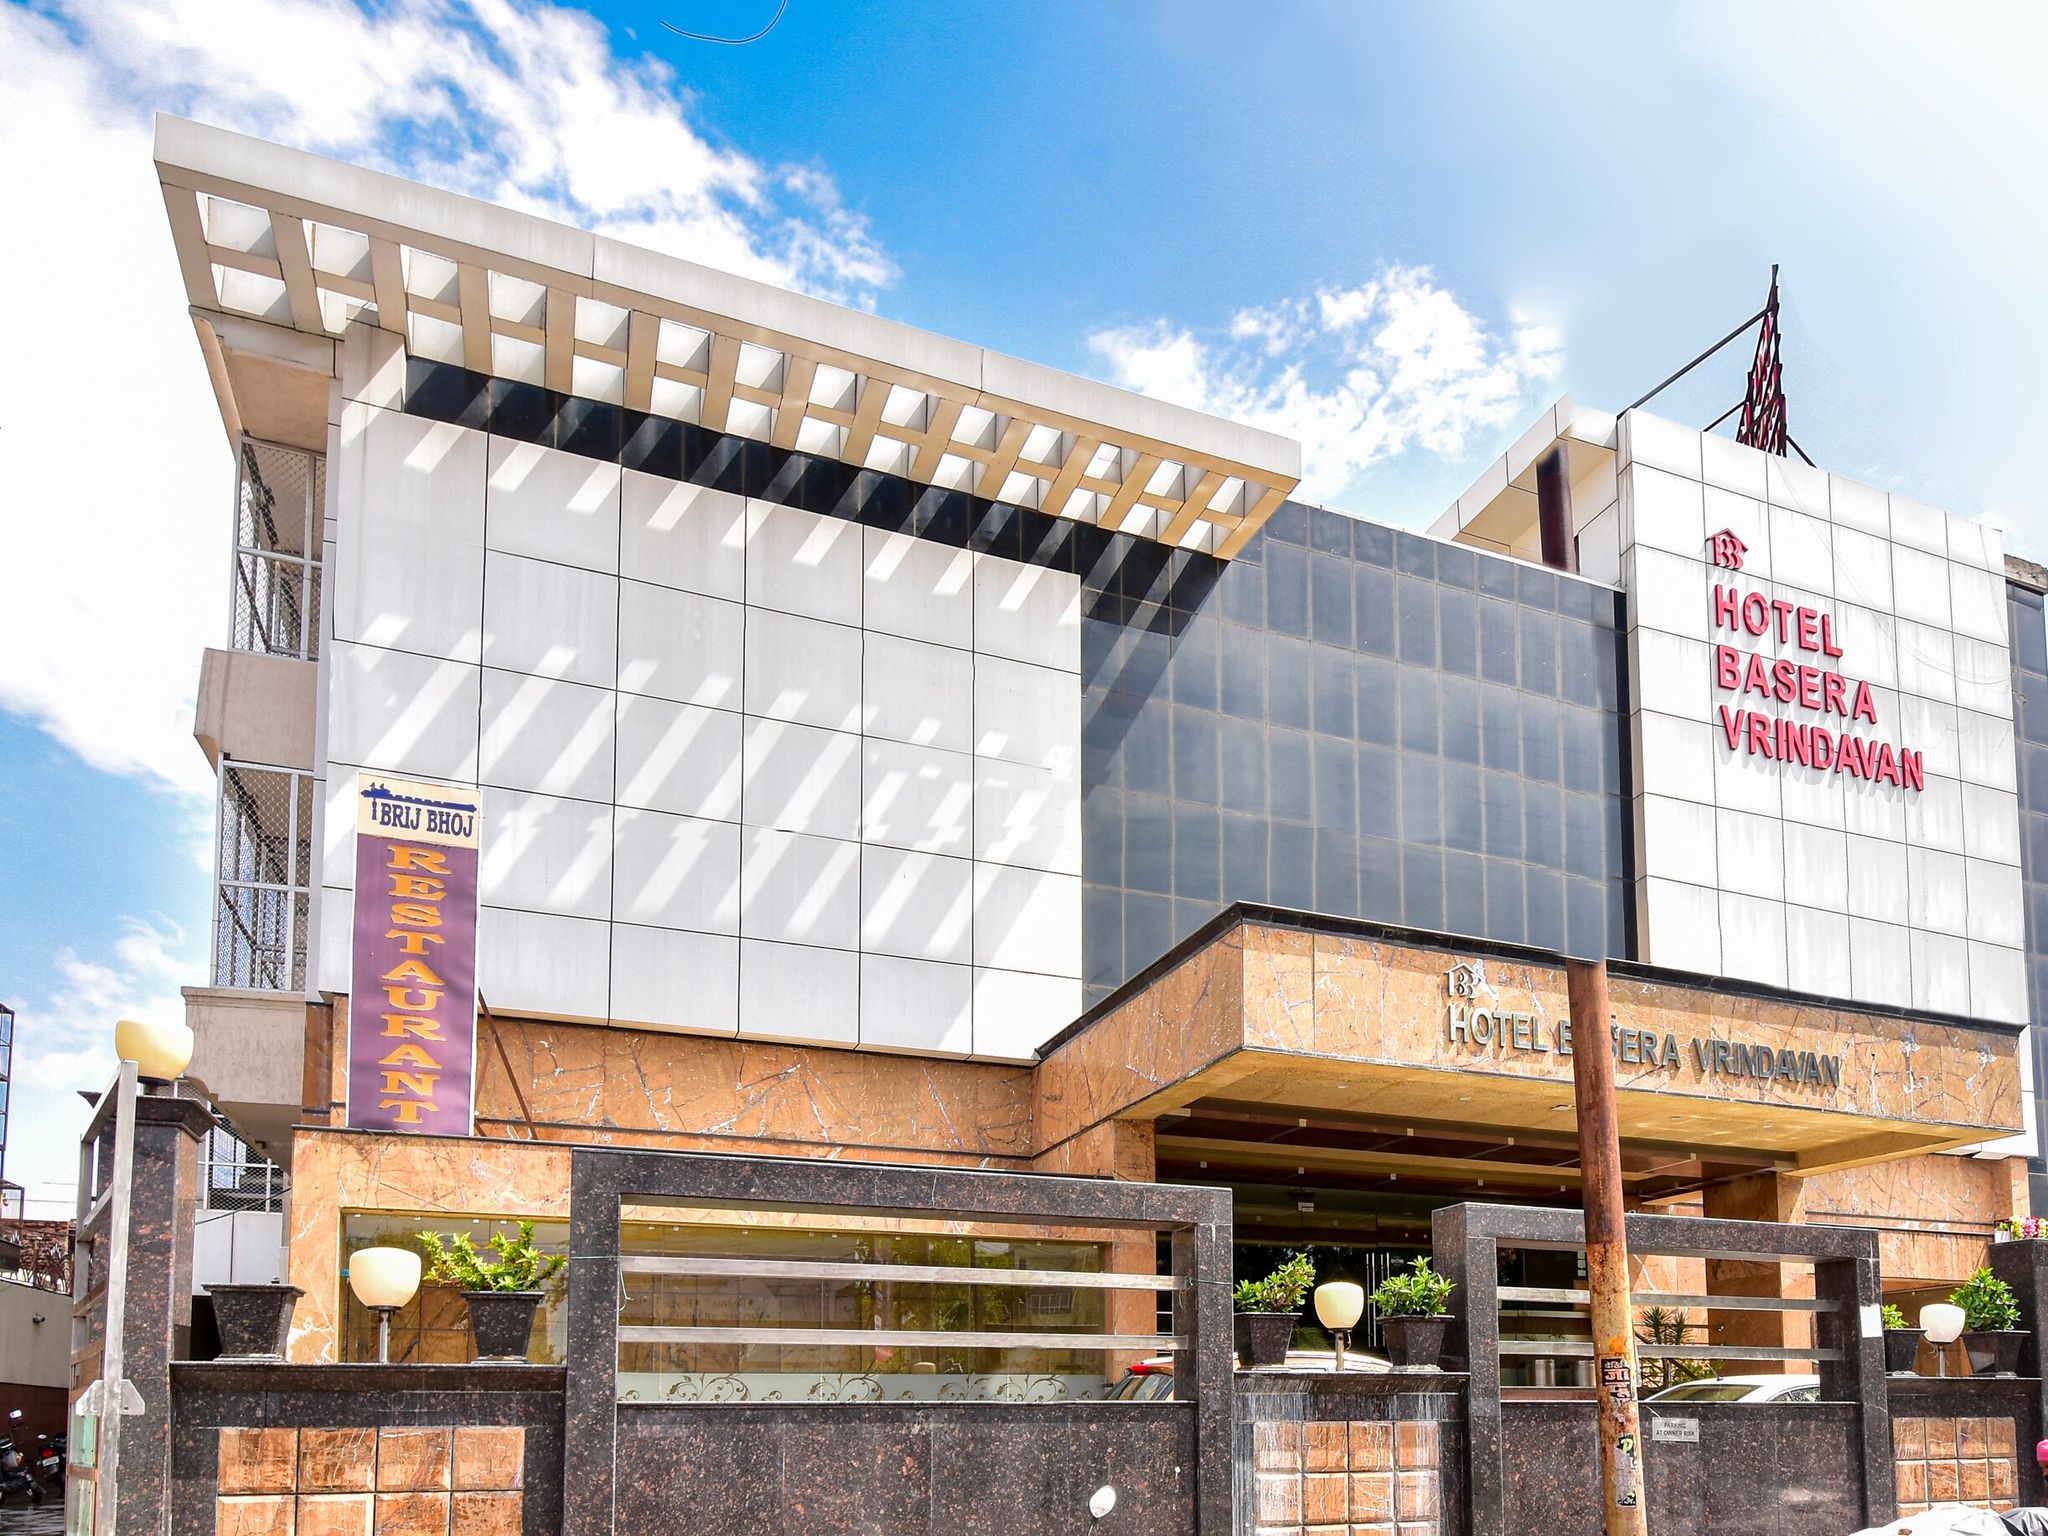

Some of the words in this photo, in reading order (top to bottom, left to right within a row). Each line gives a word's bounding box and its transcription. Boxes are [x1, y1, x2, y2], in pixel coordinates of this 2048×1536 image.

[1714, 584, 1843, 658] HOTEL
[1717, 644, 1878, 725] BASERA
[1719, 705, 1924, 791] VRINDAVAN
[380, 802, 421, 830] BRIJ
[426, 809, 474, 838] BHOJ
[378, 844, 452, 1124] RESTAURANT
[1449, 1003, 1549, 1052] HOTEL
[1558, 1019, 1681, 1068] BERA
[1693, 1037, 1840, 1088] VRINDAVAN
